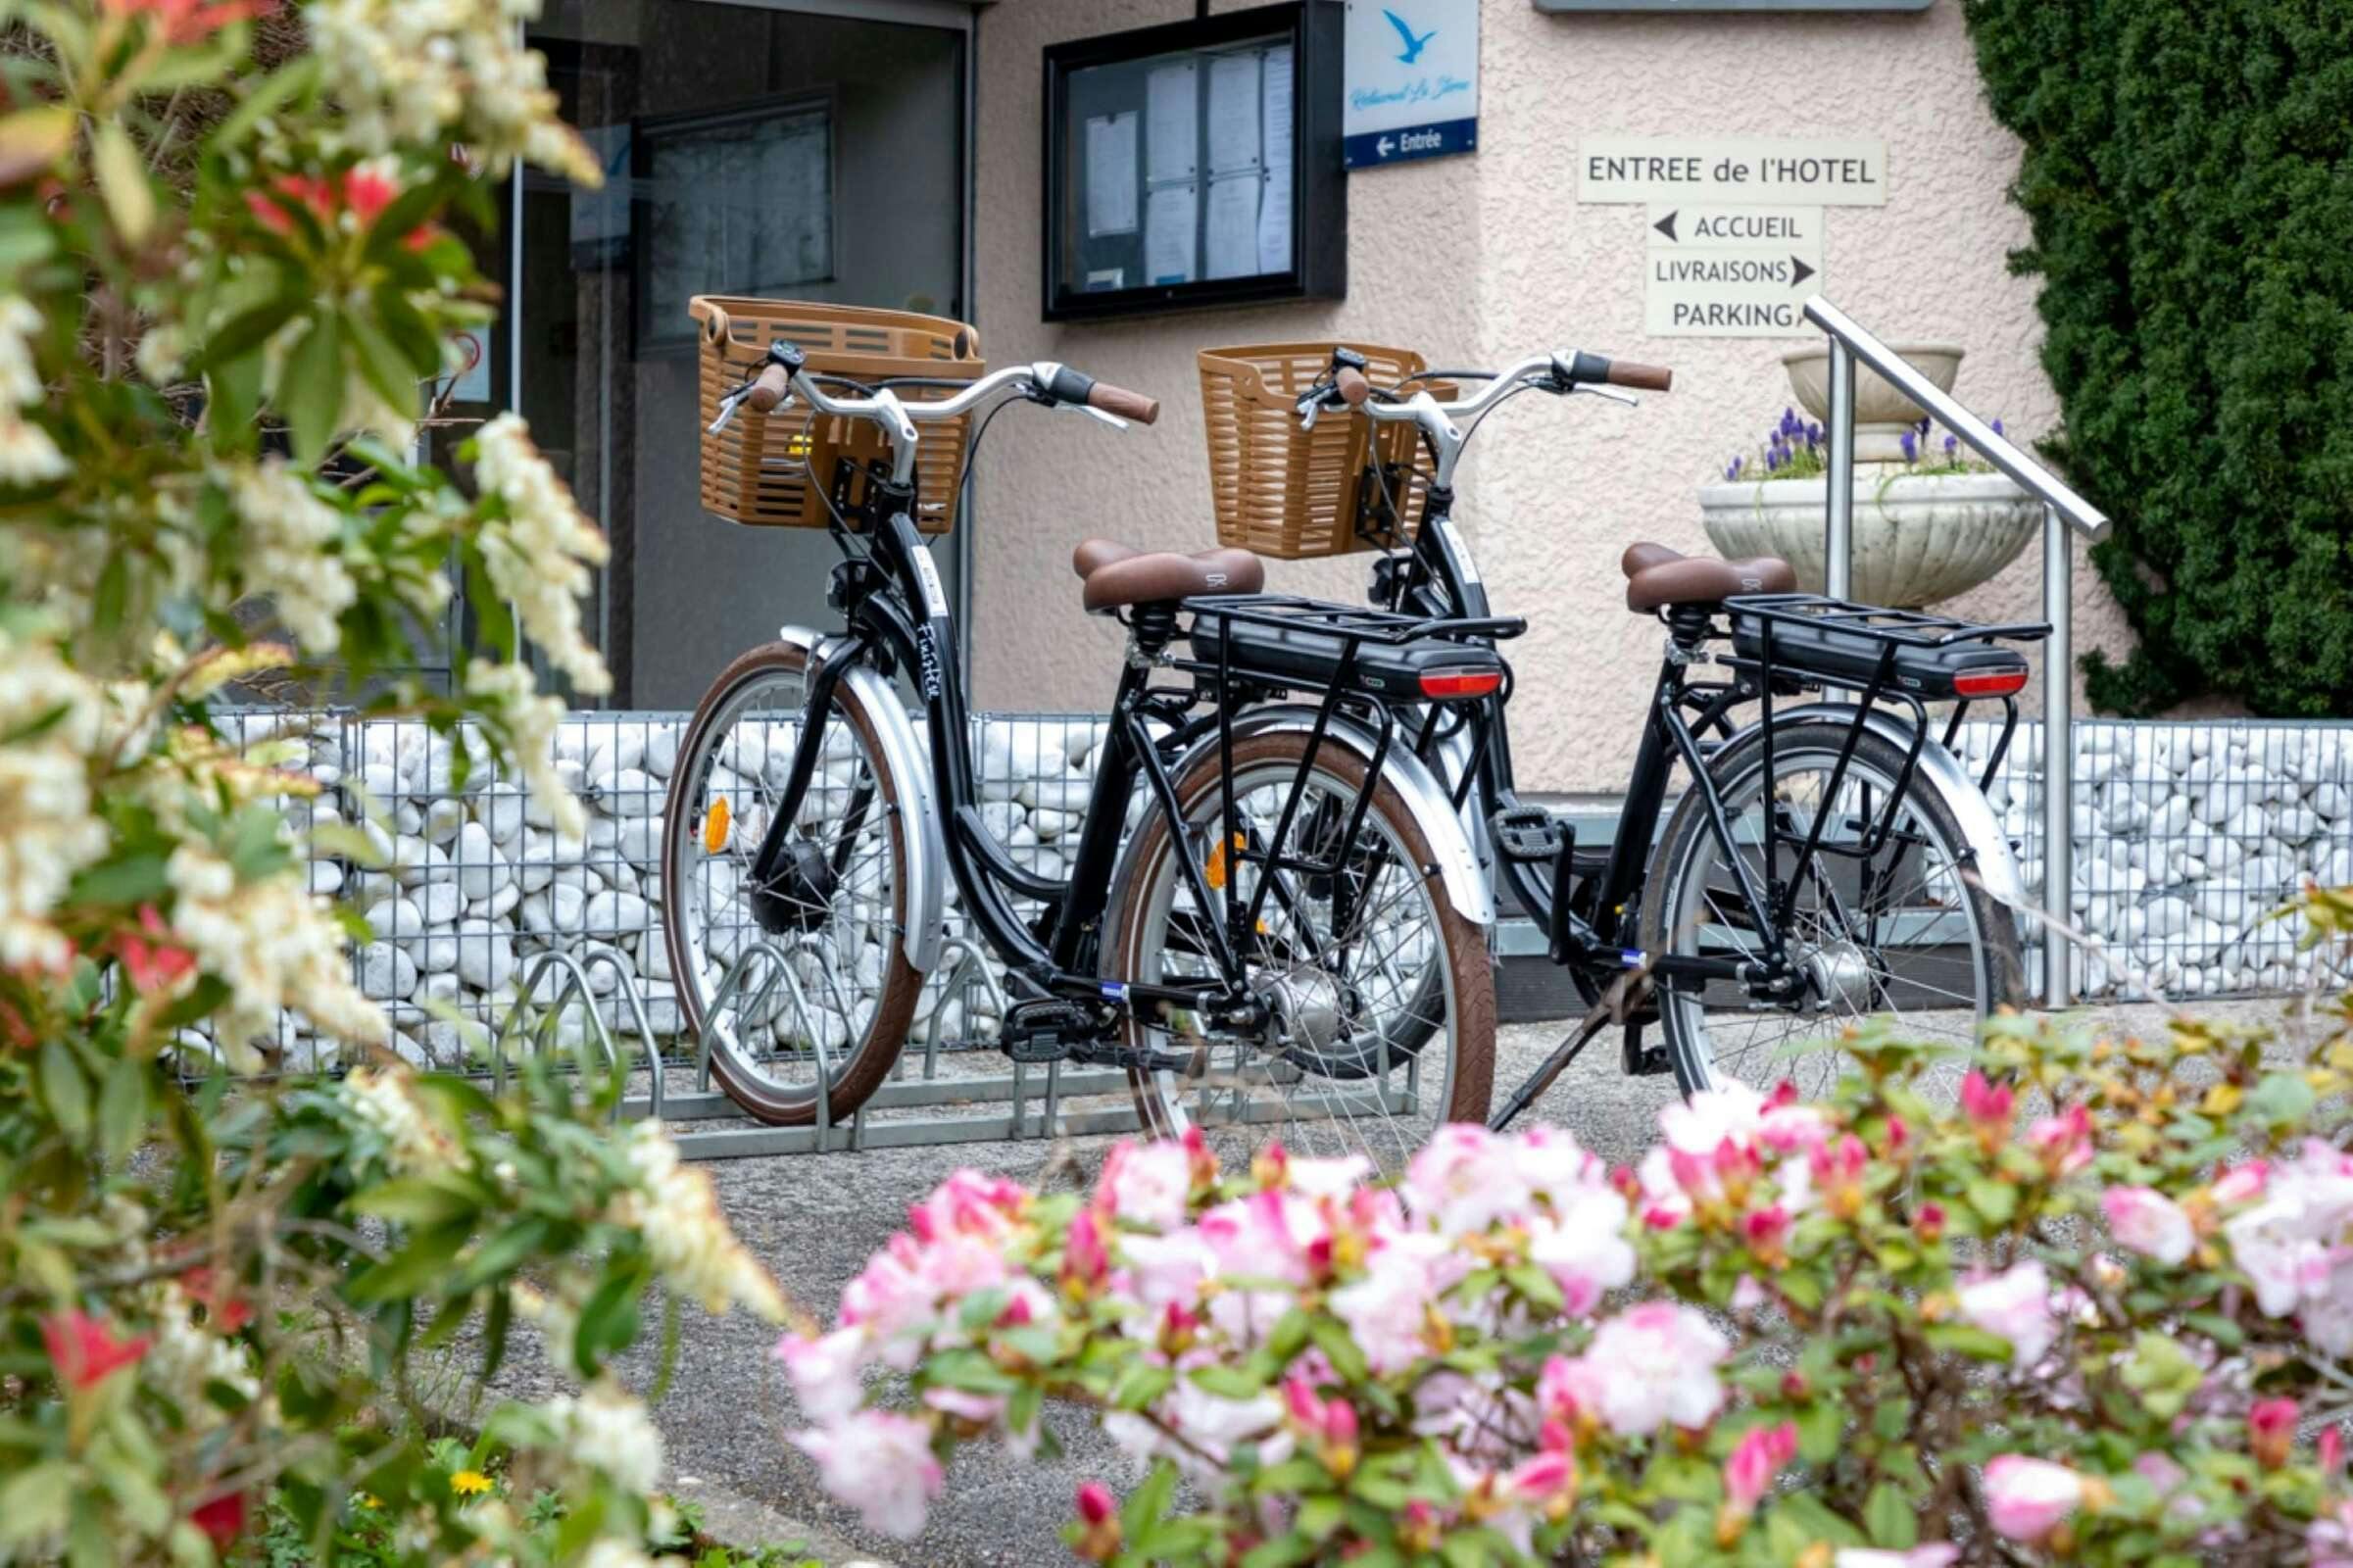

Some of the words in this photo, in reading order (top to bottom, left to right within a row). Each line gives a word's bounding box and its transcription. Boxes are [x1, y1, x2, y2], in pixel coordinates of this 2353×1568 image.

[1399, 128, 1442, 152] Entrée
[1589, 156, 1702, 181] ENTREE
[1713, 158, 1749, 182] de
[1761, 158, 1876, 184] l'HOTEL
[1694, 217, 1802, 238] ACCUEIL
[1656, 261, 1788, 282] LIVRAISONS
[1674, 303, 1792, 327] PARKING
